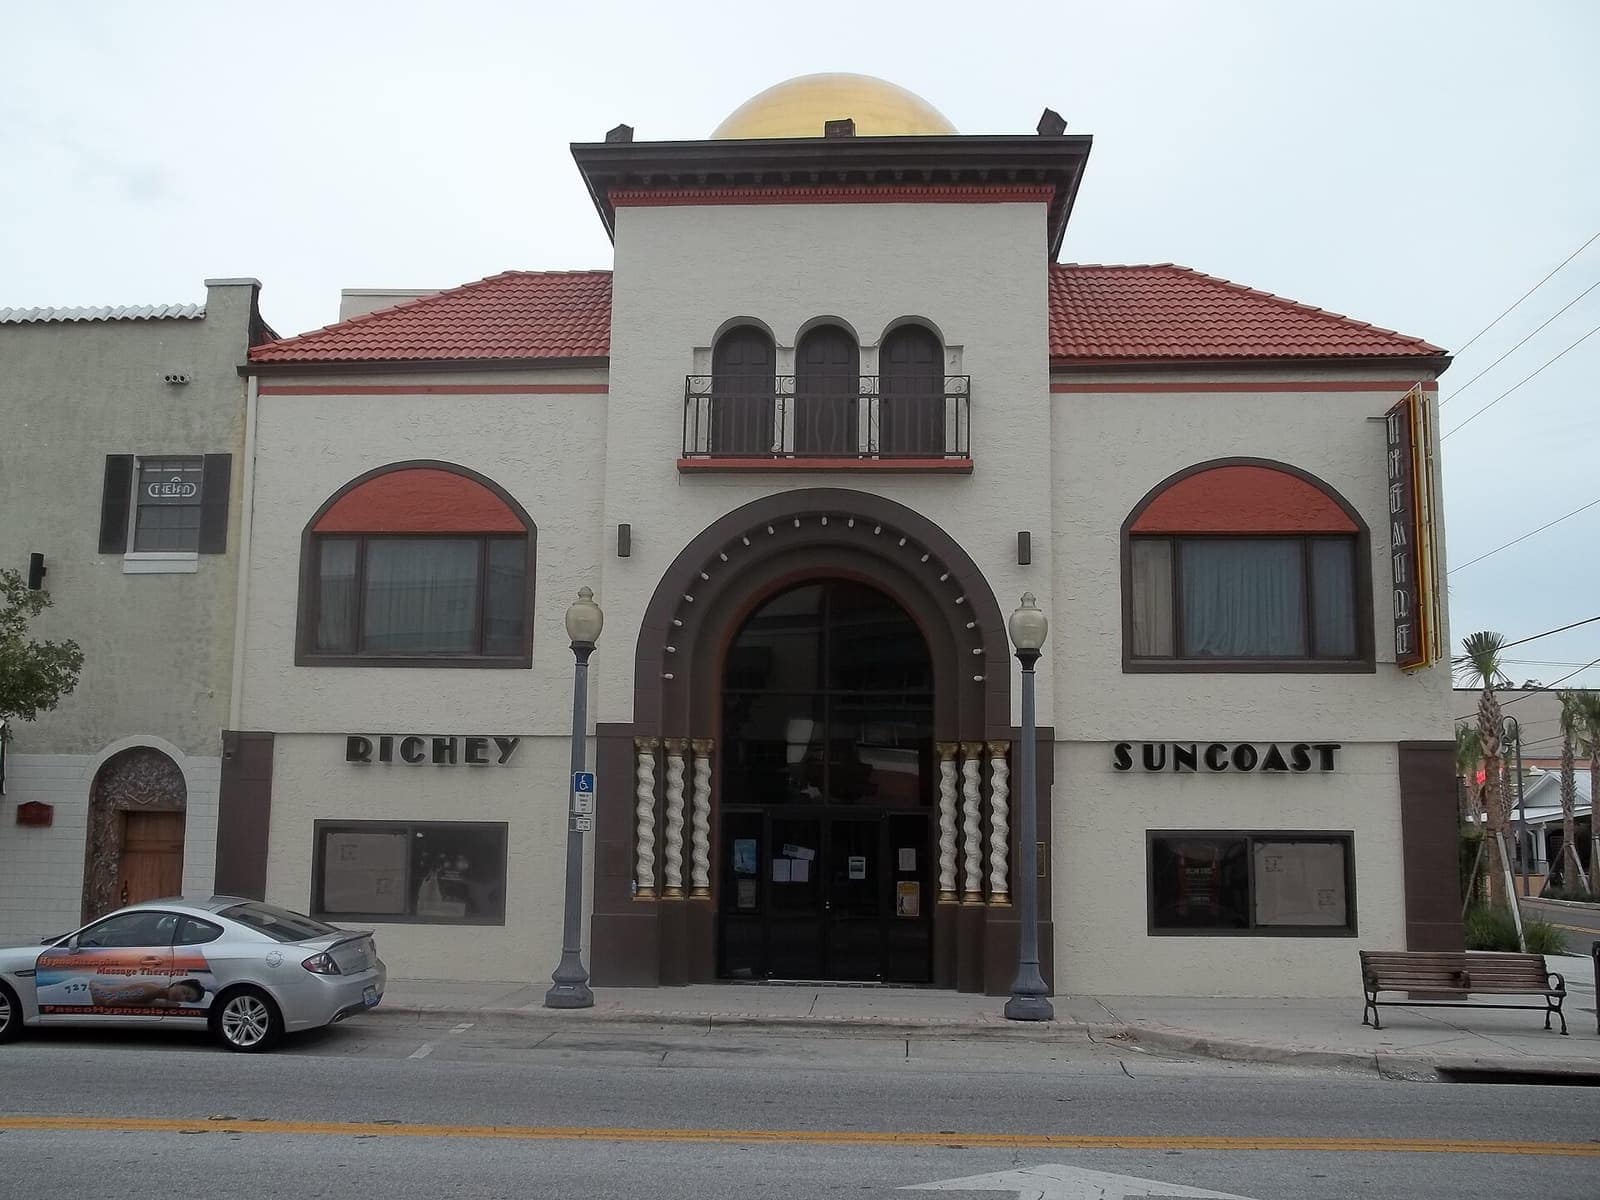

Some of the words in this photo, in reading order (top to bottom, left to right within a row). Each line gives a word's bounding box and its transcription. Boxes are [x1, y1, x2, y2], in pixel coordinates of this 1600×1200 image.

[345, 735, 521, 764] RICHEY
[1112, 742, 1342, 772] SUNCOAST
[96, 967, 138, 977] Massage
[139, 967, 190, 977] Therapist
[64, 983, 88, 994] 727
[43, 1005, 202, 1016] PascoHypnosis.com
